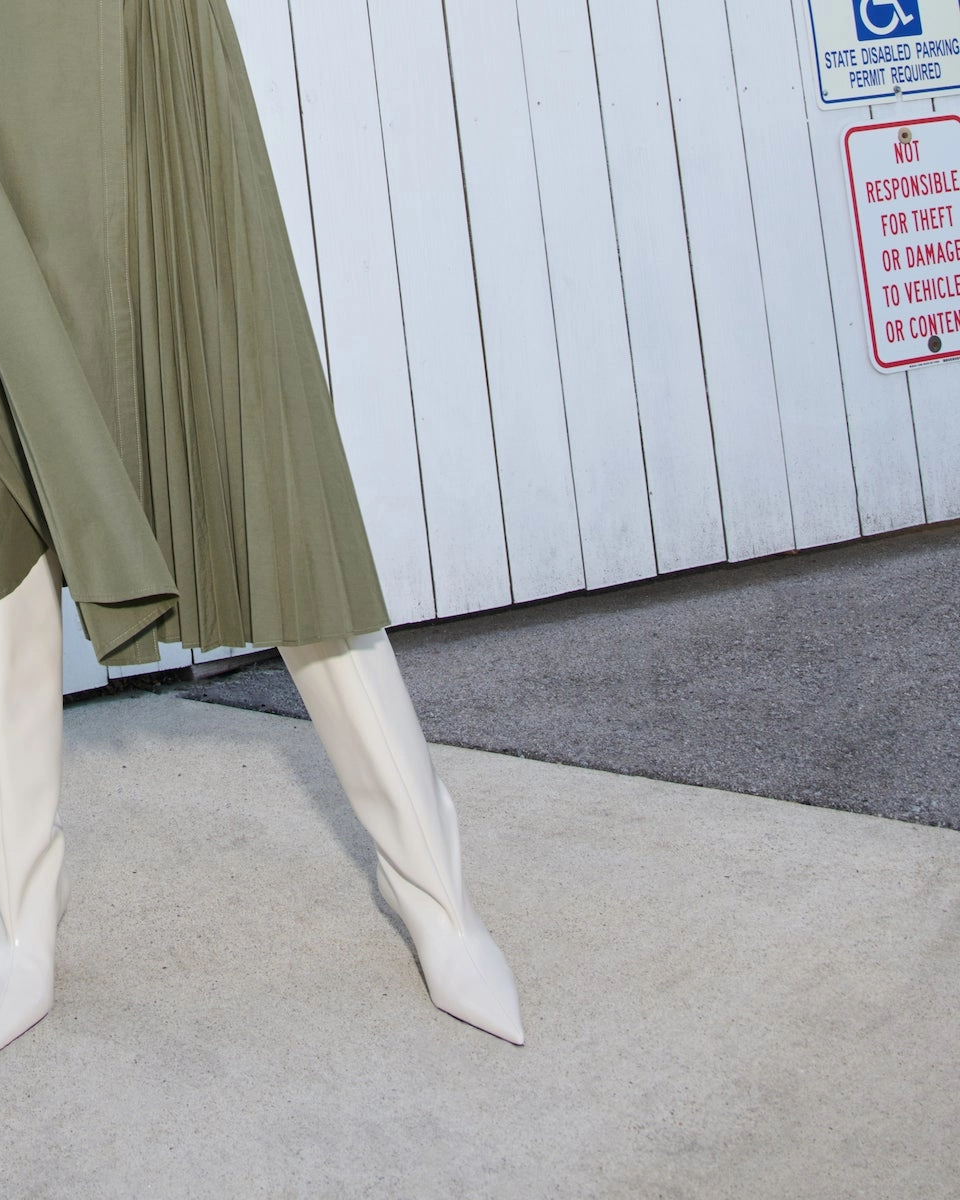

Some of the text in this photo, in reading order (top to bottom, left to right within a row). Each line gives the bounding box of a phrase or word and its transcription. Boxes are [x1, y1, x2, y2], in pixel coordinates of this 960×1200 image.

[824, 38, 960, 70] STATE DISABLED PARKING
[849, 61, 942, 89] PERMIT REQUIRED
[893, 140, 920, 165] NOT
[865, 169, 960, 204] RESPONSIBLE
[880, 205, 954, 237] FOR THEFT
[882, 238, 960, 273] OR DAMAGE
[882, 273, 960, 308] TO VEHICLE
[885, 319, 905, 344] OR
